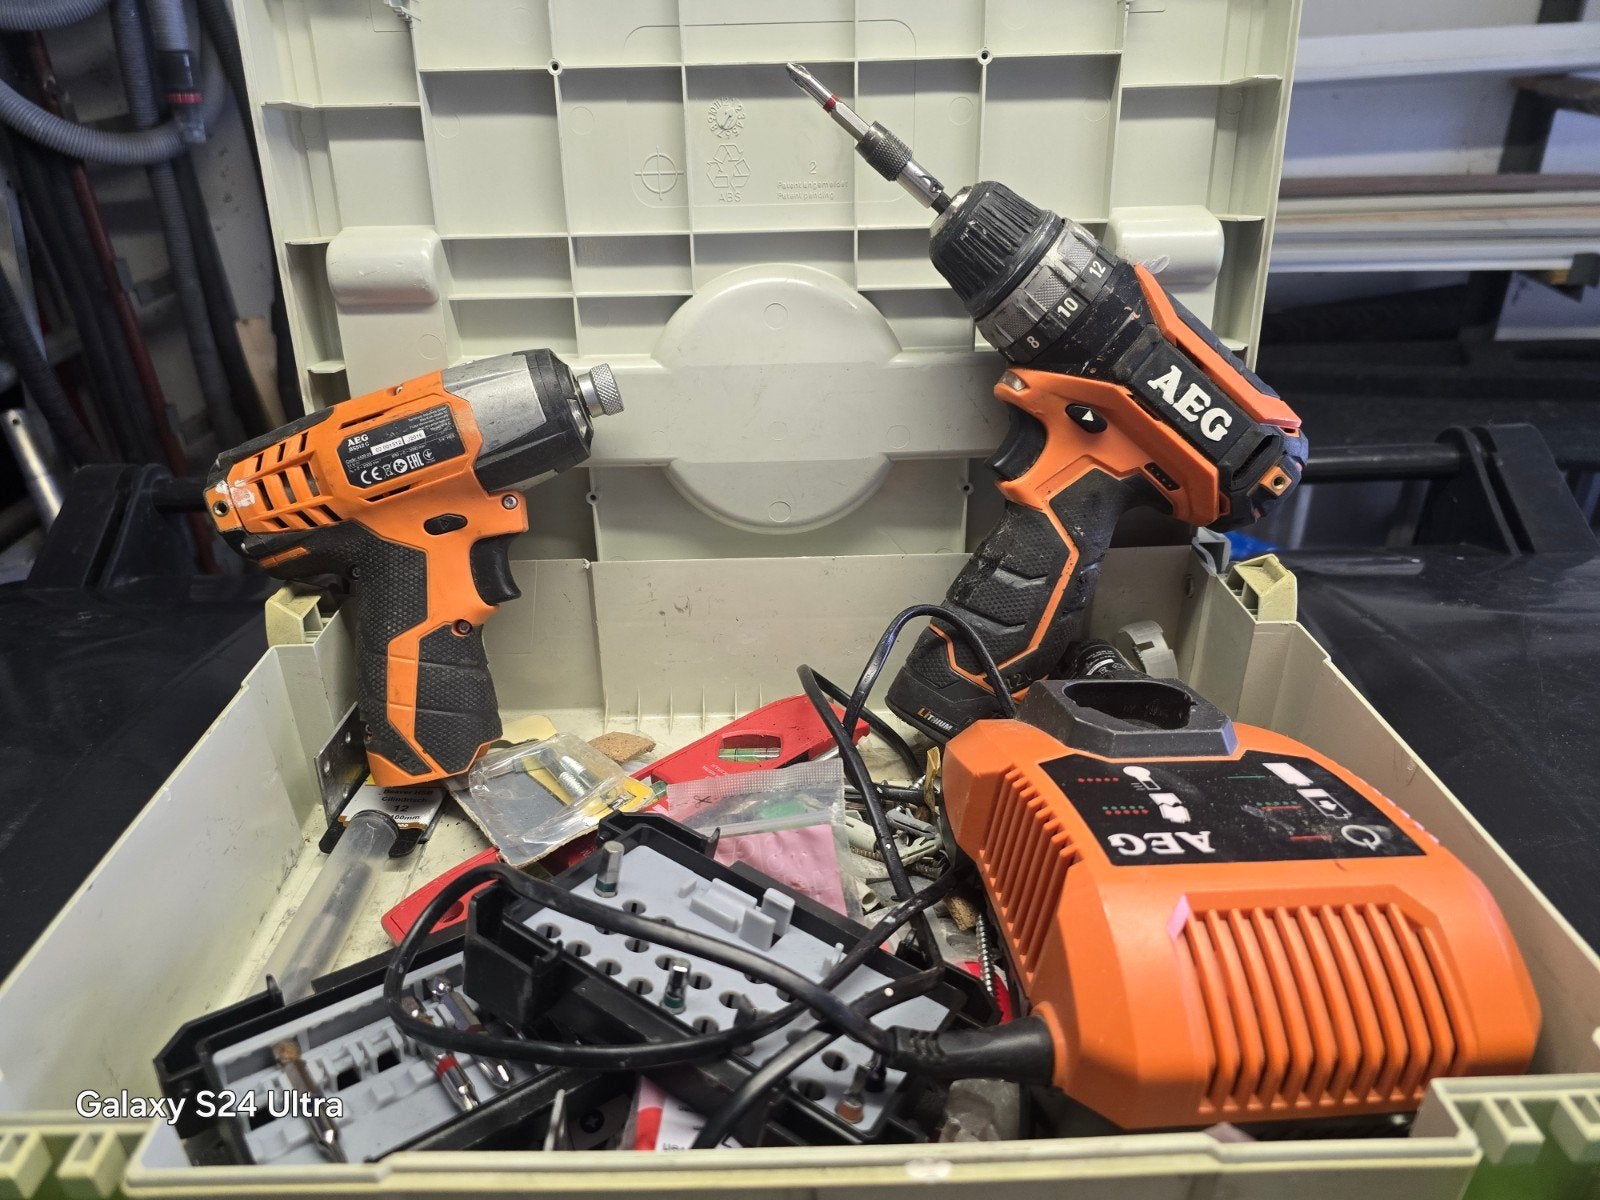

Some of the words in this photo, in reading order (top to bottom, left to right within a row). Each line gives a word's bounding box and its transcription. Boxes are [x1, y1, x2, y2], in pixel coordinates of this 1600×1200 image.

[808, 160, 818, 174] 2
[718, 191, 743, 203] ABS
[1089, 260, 1107, 279] 12
[1057, 298, 1078, 318] 10
[1026, 335, 1040, 349] 8
[1147, 364, 1233, 442] AEG
[347, 433, 370, 448] AEG
[394, 804, 409, 812] 12
[1107, 830, 1216, 856] AEG
